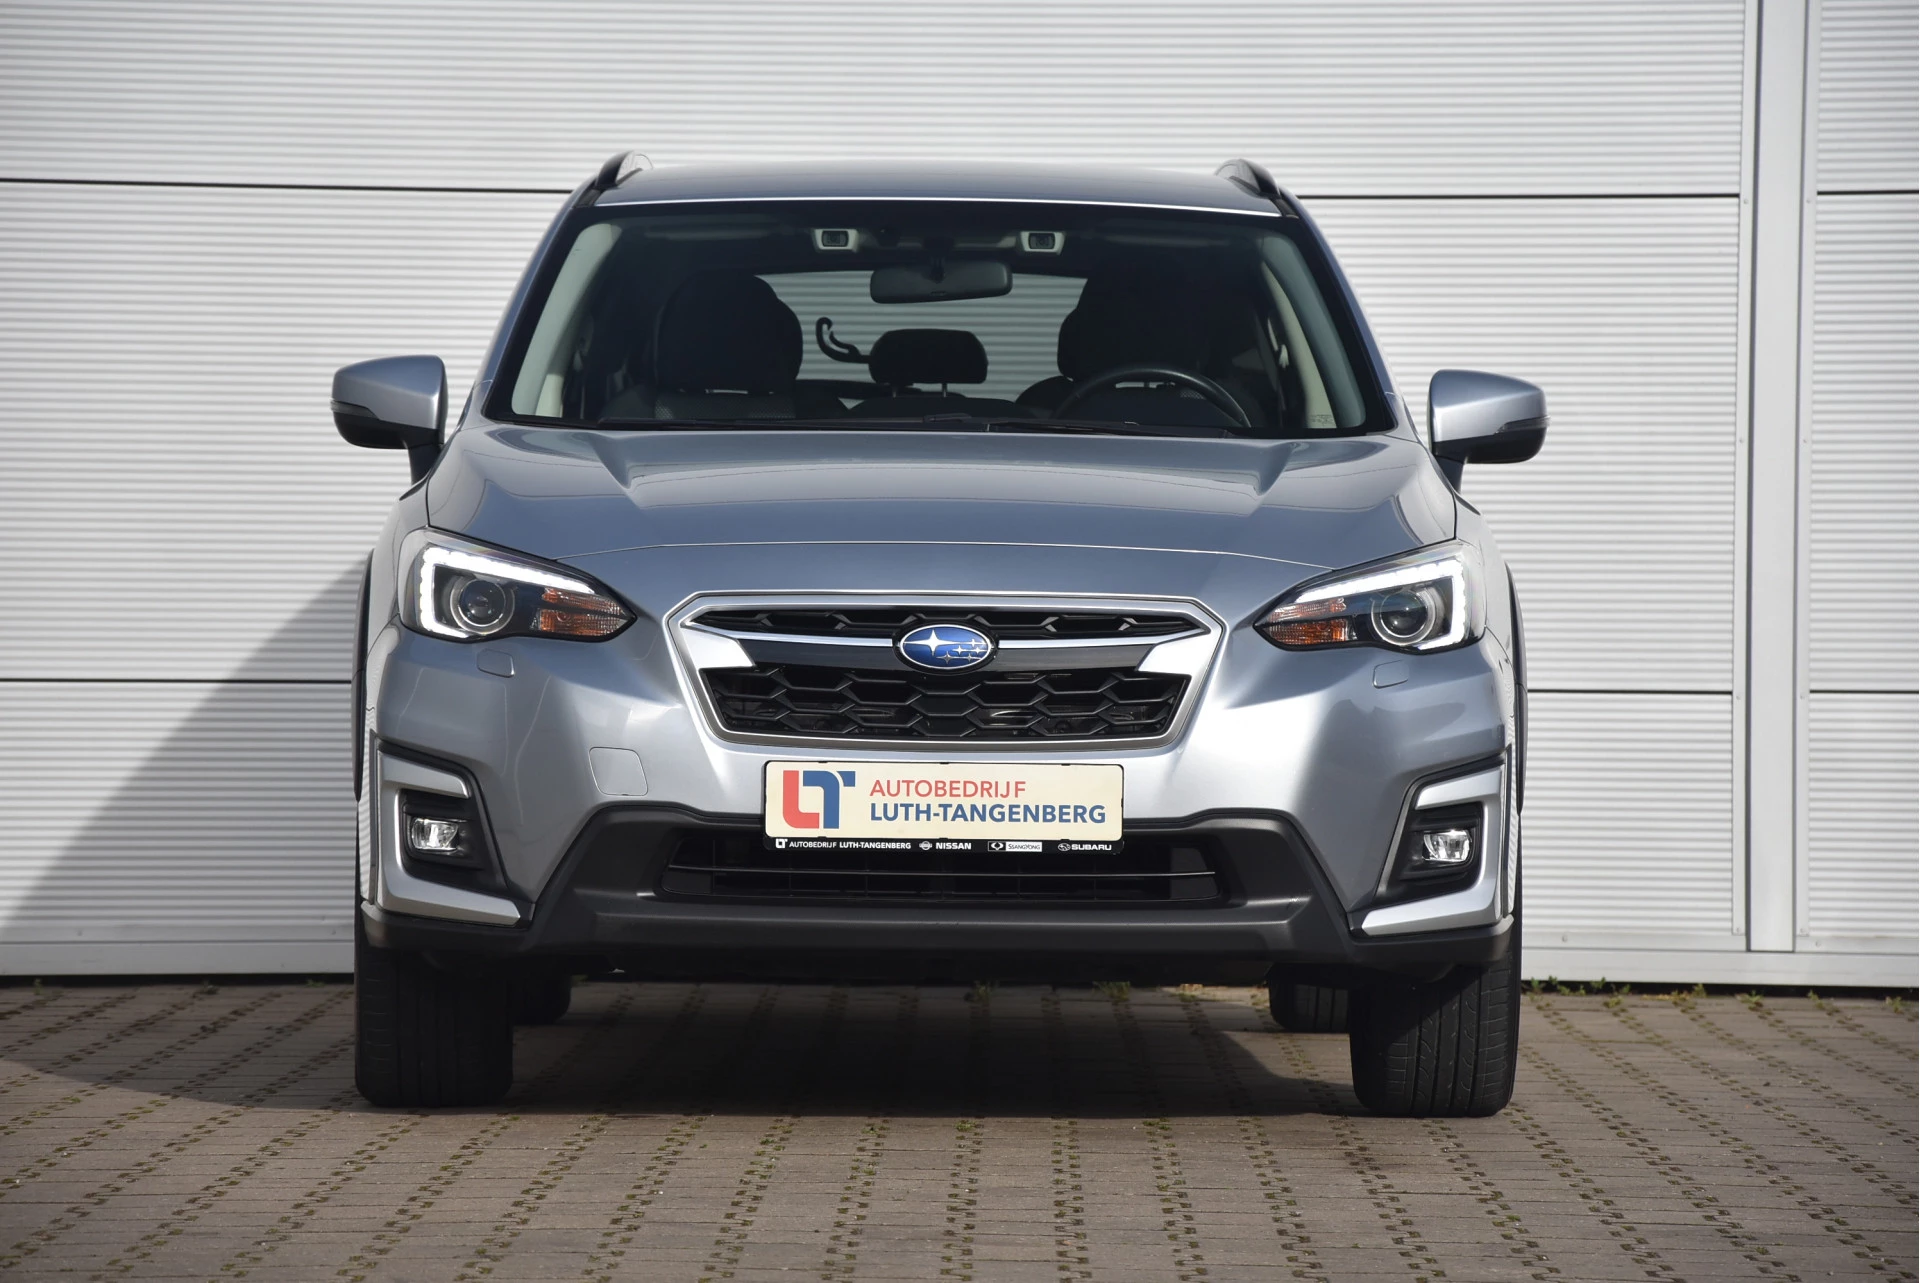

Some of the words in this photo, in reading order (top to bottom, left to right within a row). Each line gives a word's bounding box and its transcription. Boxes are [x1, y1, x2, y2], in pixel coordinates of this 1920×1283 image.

[869, 779, 1027, 799] AUTOBEDRIJF
[870, 803, 1107, 824] LUTH-TANGENBERG
[789, 840, 837, 848] AUTOBEDRIJF
[839, 841, 912, 850] LUTH-TANGENBERG
[935, 842, 972, 850] NISSAN
[1071, 843, 1112, 851] SUBARU
